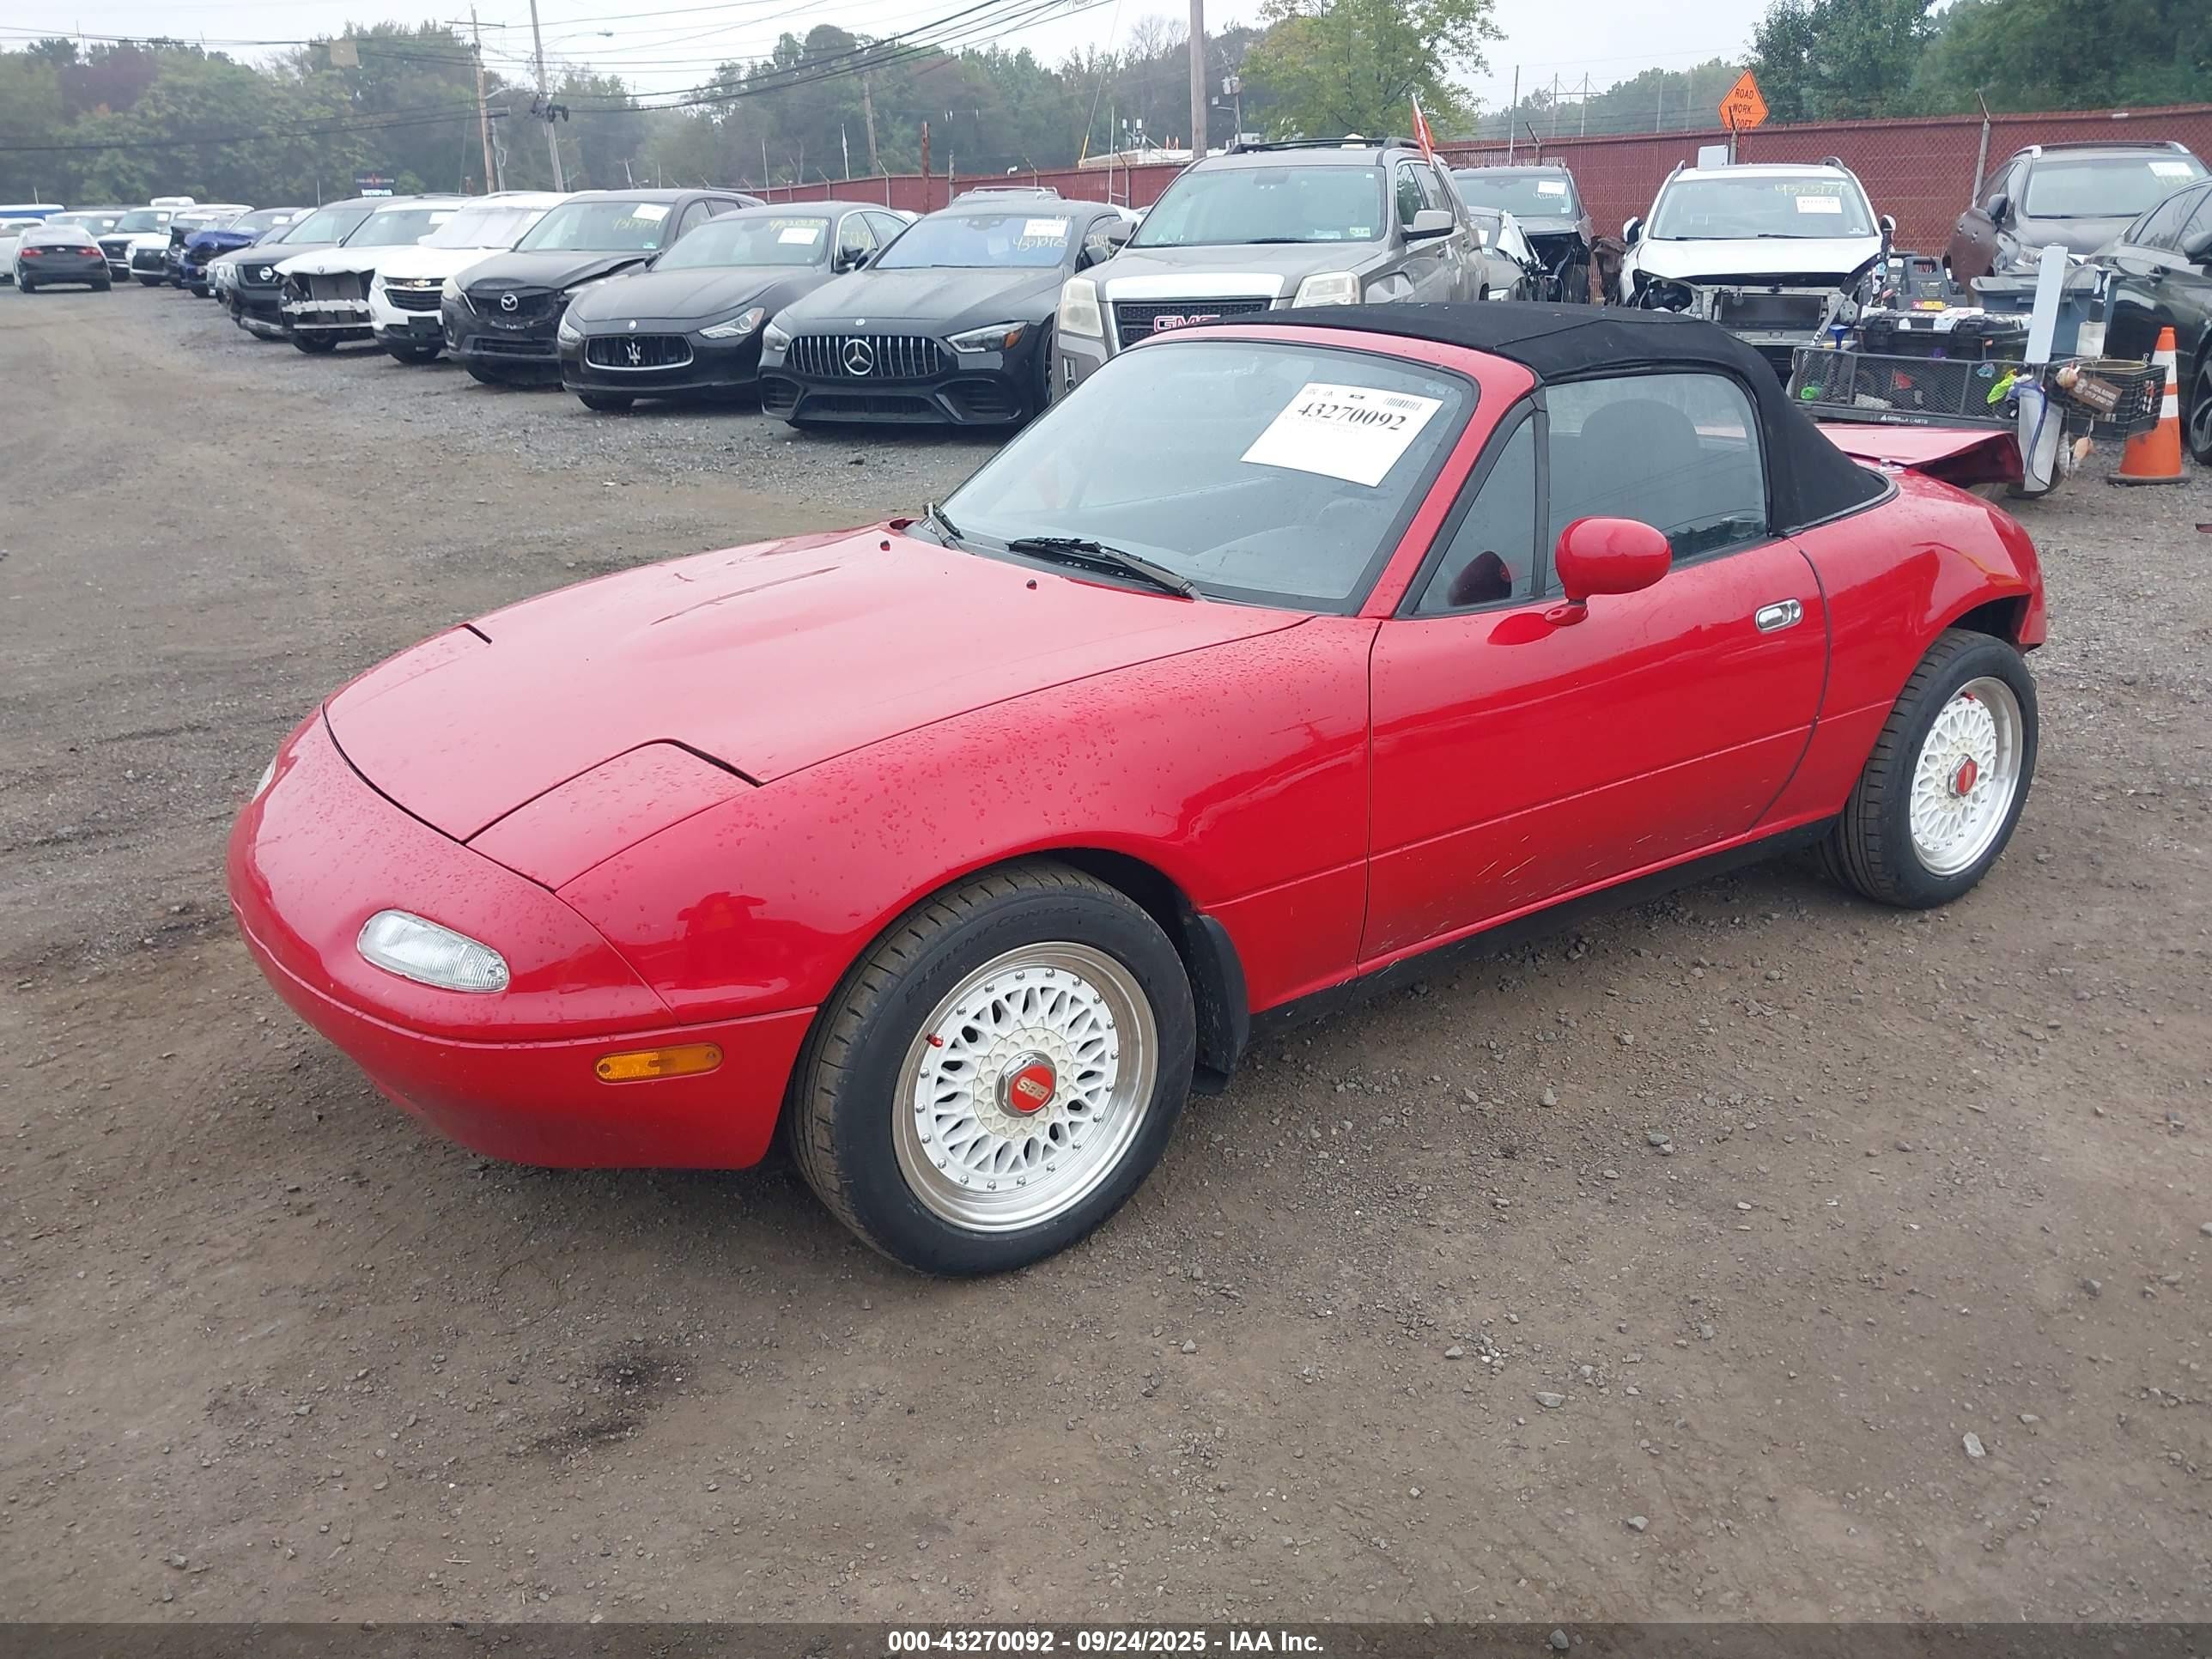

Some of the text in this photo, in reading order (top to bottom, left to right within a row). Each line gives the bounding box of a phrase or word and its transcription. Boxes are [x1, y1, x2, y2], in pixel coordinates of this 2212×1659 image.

[1735, 88, 1754, 100] ROAD
[1733, 102, 1753, 114] WORK
[1297, 401, 1407, 431] 43270092
[1017, 1076, 1050, 1101] BBS
